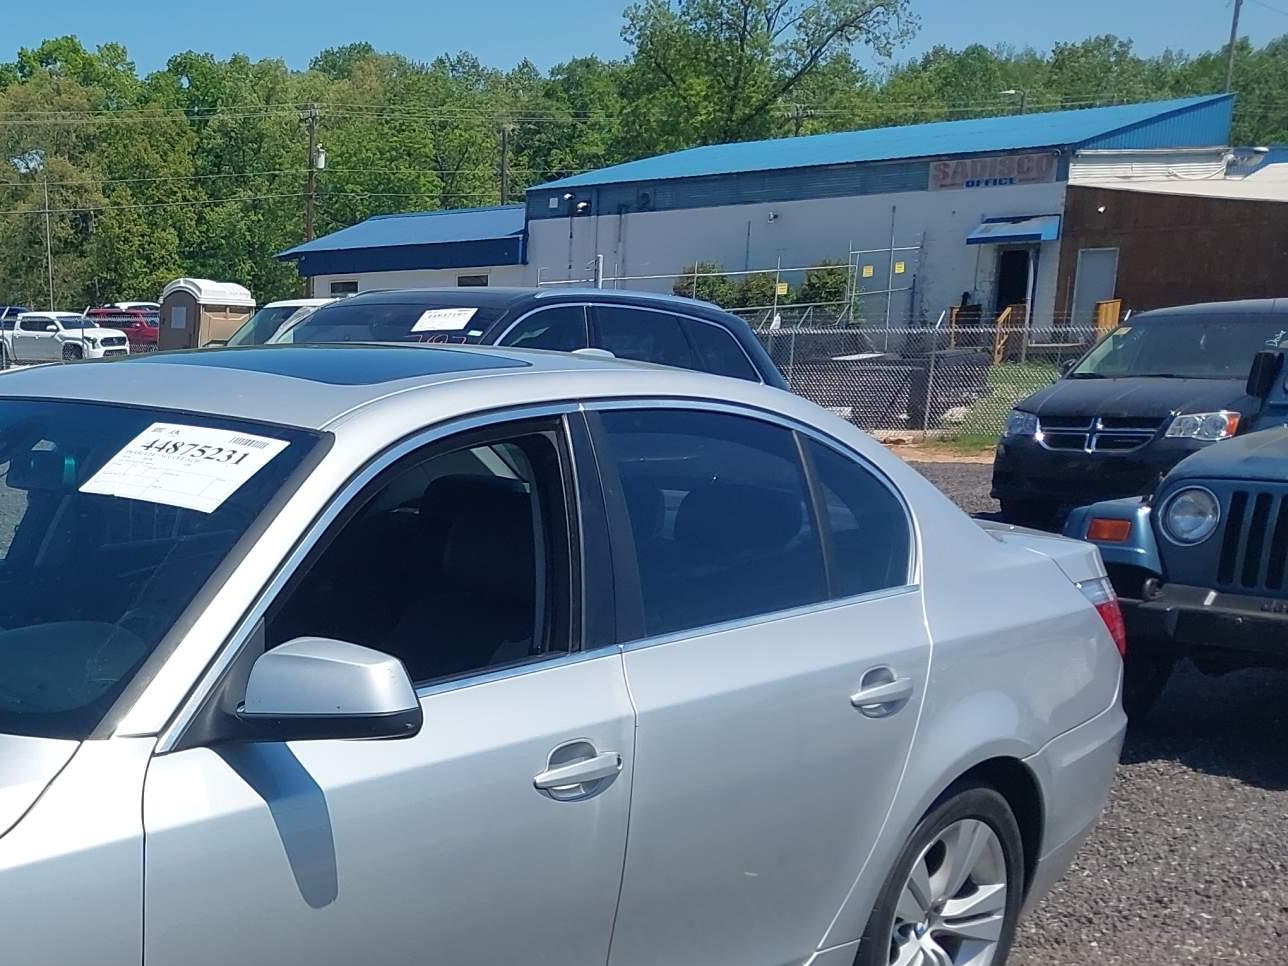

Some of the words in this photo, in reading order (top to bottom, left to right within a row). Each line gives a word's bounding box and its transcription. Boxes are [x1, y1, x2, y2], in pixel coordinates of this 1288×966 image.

[933, 155, 1054, 184] SADISCO
[965, 177, 1017, 188] OFFICE
[140, 438, 250, 465] 44875231
